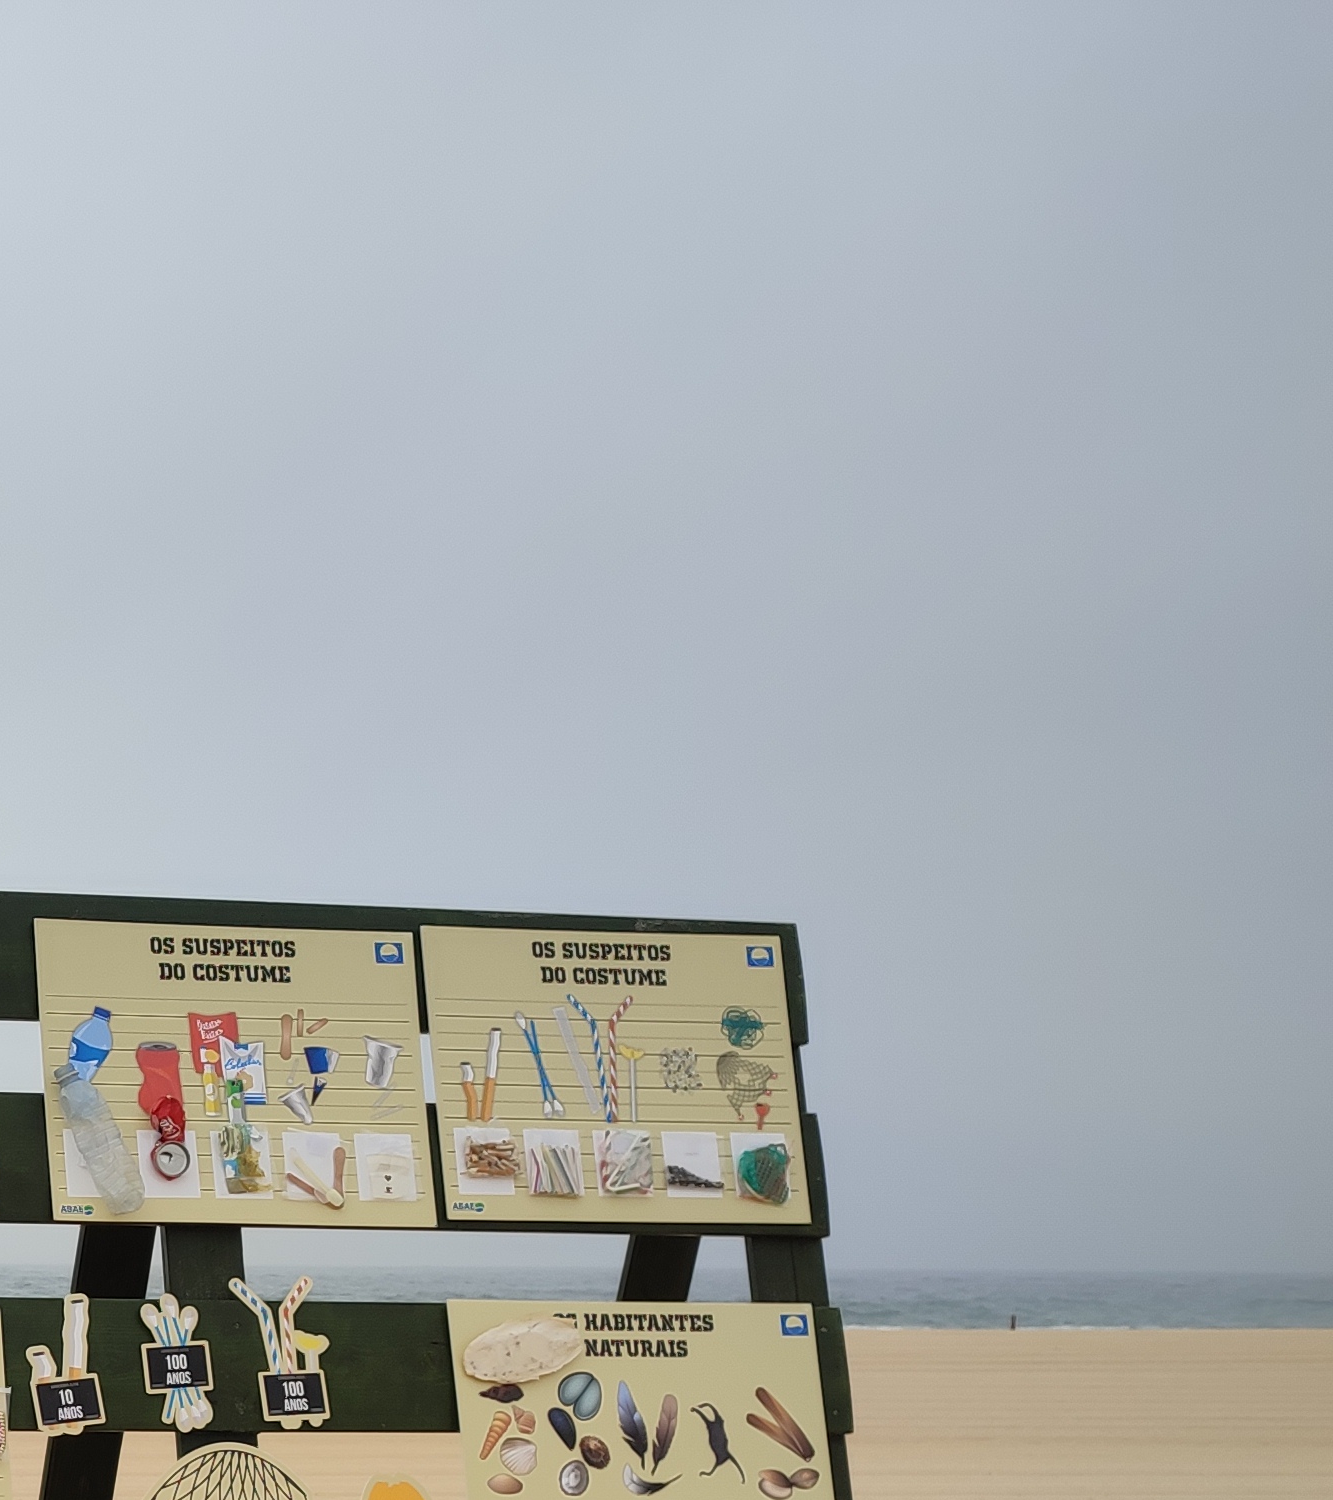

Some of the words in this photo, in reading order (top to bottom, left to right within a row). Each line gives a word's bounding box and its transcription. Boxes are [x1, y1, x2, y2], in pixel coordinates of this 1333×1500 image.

[150, 937, 175, 955] OS
[182, 938, 297, 958] SUSPEITOS
[532, 942, 555, 959] OS
[562, 942, 671, 961] SUSPEITOS
[159, 962, 185, 981] DO
[192, 963, 291, 983] COSTUME
[541, 966, 566, 984] DO
[573, 967, 668, 986] COSTUME
[584, 1313, 714, 1332] HABITANTES
[584, 1339, 689, 1357] NATURAIS
[165, 1354, 188, 1370] 100
[166, 1371, 192, 1385] ANOS
[58, 1389, 74, 1405] 10
[282, 1381, 305, 1397] 100
[284, 1398, 309, 1411] ANOS
[58, 1406, 83, 1421] ANOS
